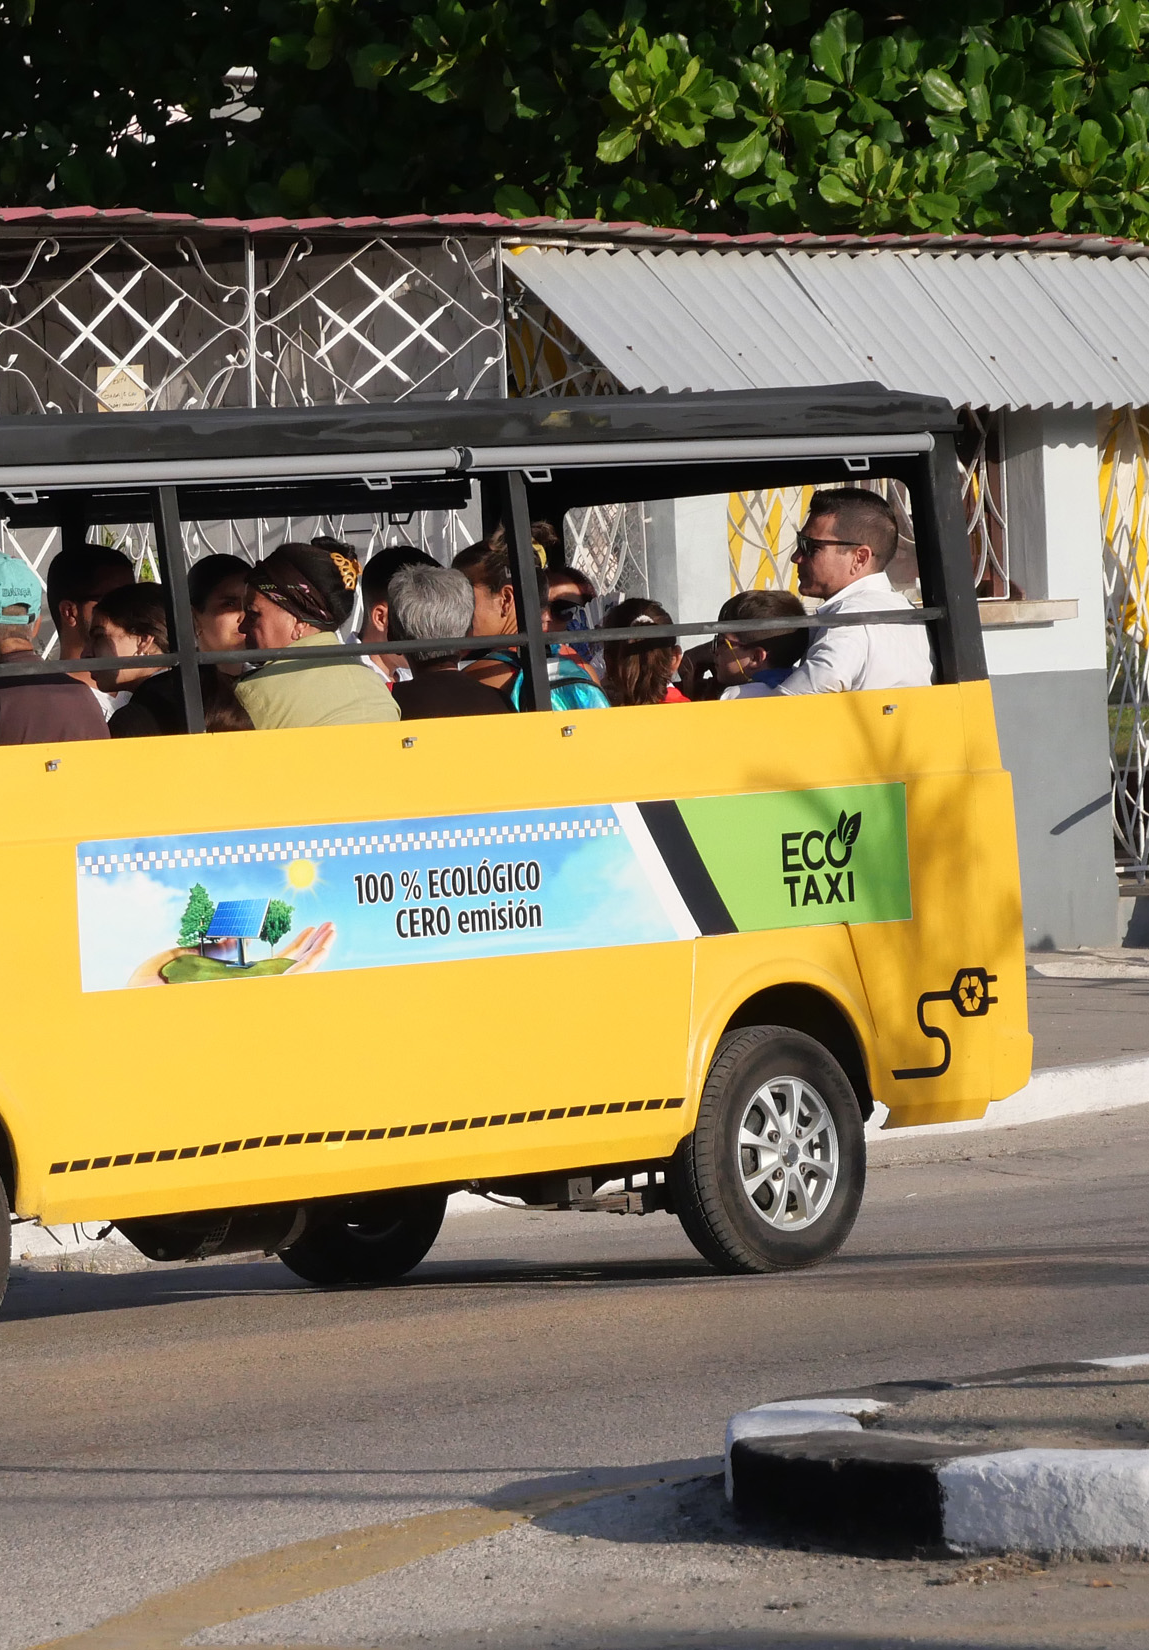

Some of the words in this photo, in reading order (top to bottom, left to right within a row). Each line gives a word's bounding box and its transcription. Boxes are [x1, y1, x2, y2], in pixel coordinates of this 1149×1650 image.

[781, 830, 853, 872] ECO
[354, 873, 395, 904] 100
[400, 870, 423, 900] %
[427, 858, 542, 899] ECOLÓGICO
[783, 871, 855, 907] TAXI
[396, 905, 451, 939] CERO
[457, 899, 542, 934] emisión
